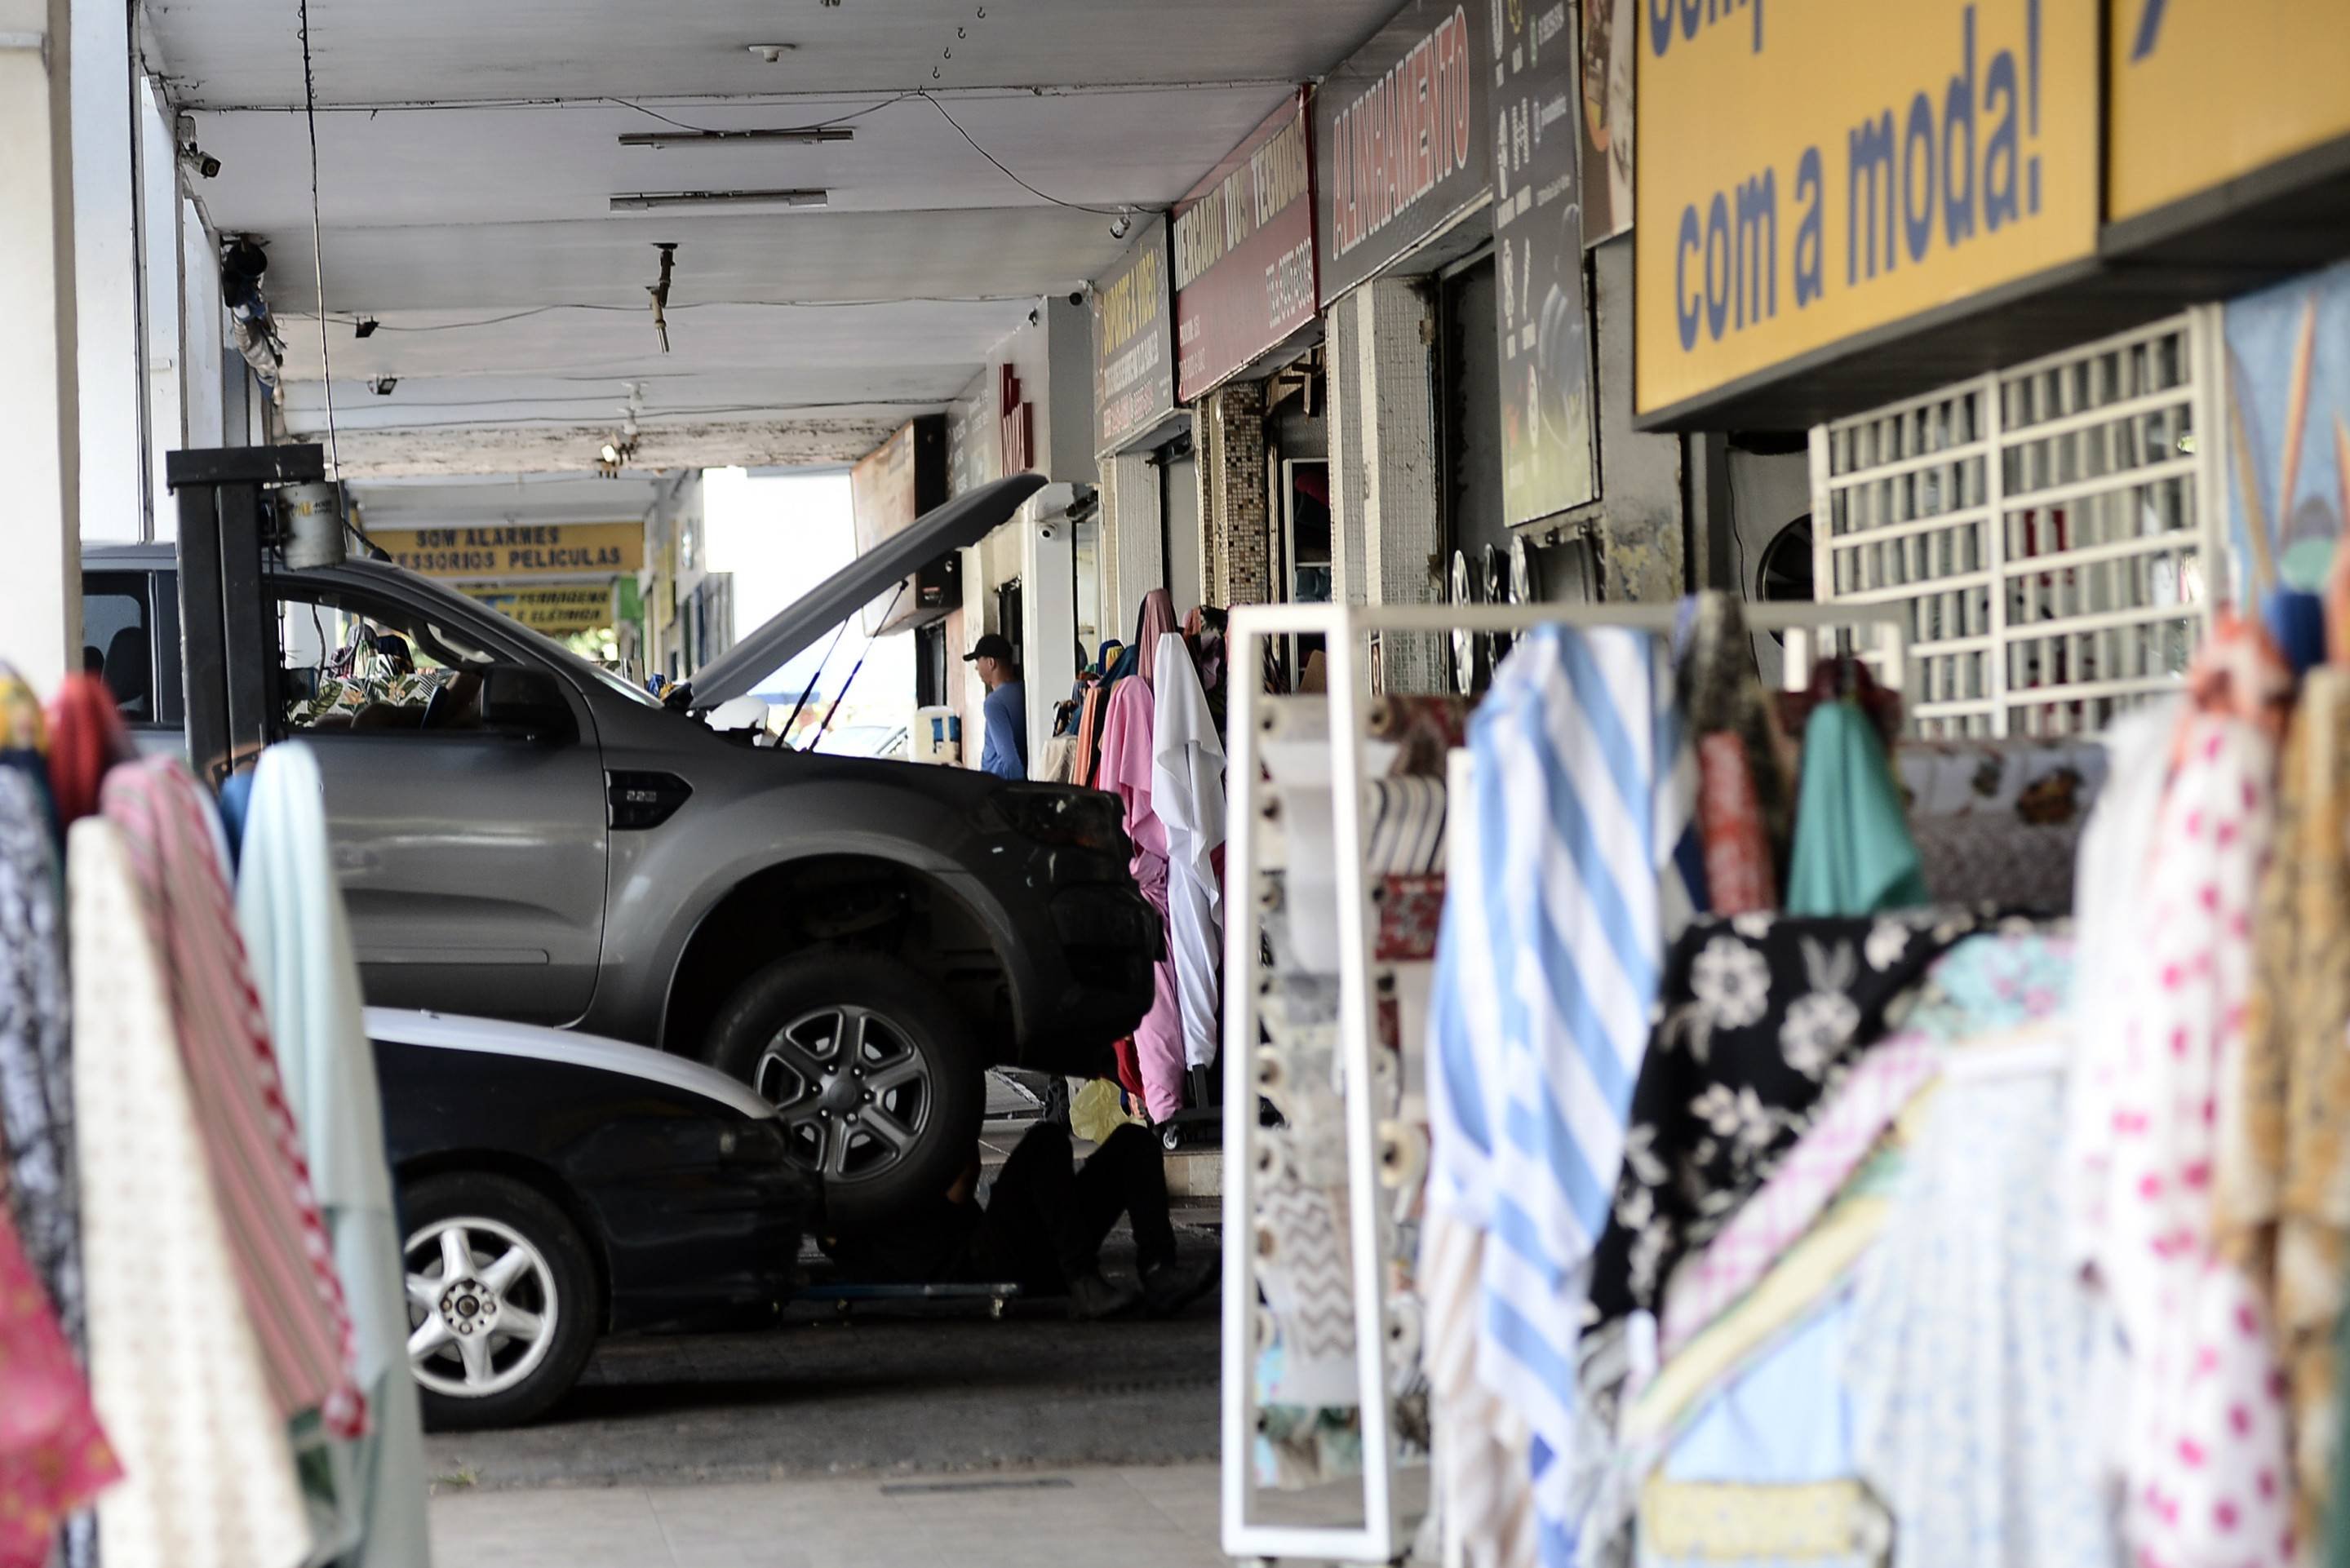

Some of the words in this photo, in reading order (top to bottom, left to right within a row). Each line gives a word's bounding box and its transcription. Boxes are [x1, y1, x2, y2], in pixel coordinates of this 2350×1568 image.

[1173, 186, 1223, 292] MERCADO
[1224, 166, 1249, 253] DOS
[1250, 111, 1307, 229] TECIDOS
[1333, 4, 1469, 261] ALINHAMENTO
[1676, 166, 1777, 353] com
[1794, 144, 1823, 311] a
[1847, 0, 2042, 289] moda!
[391, 551, 495, 570] ESSORIOS
[508, 546, 620, 569] PELICULAS
[416, 529, 456, 547] SOM
[465, 525, 560, 547] ALARMES
